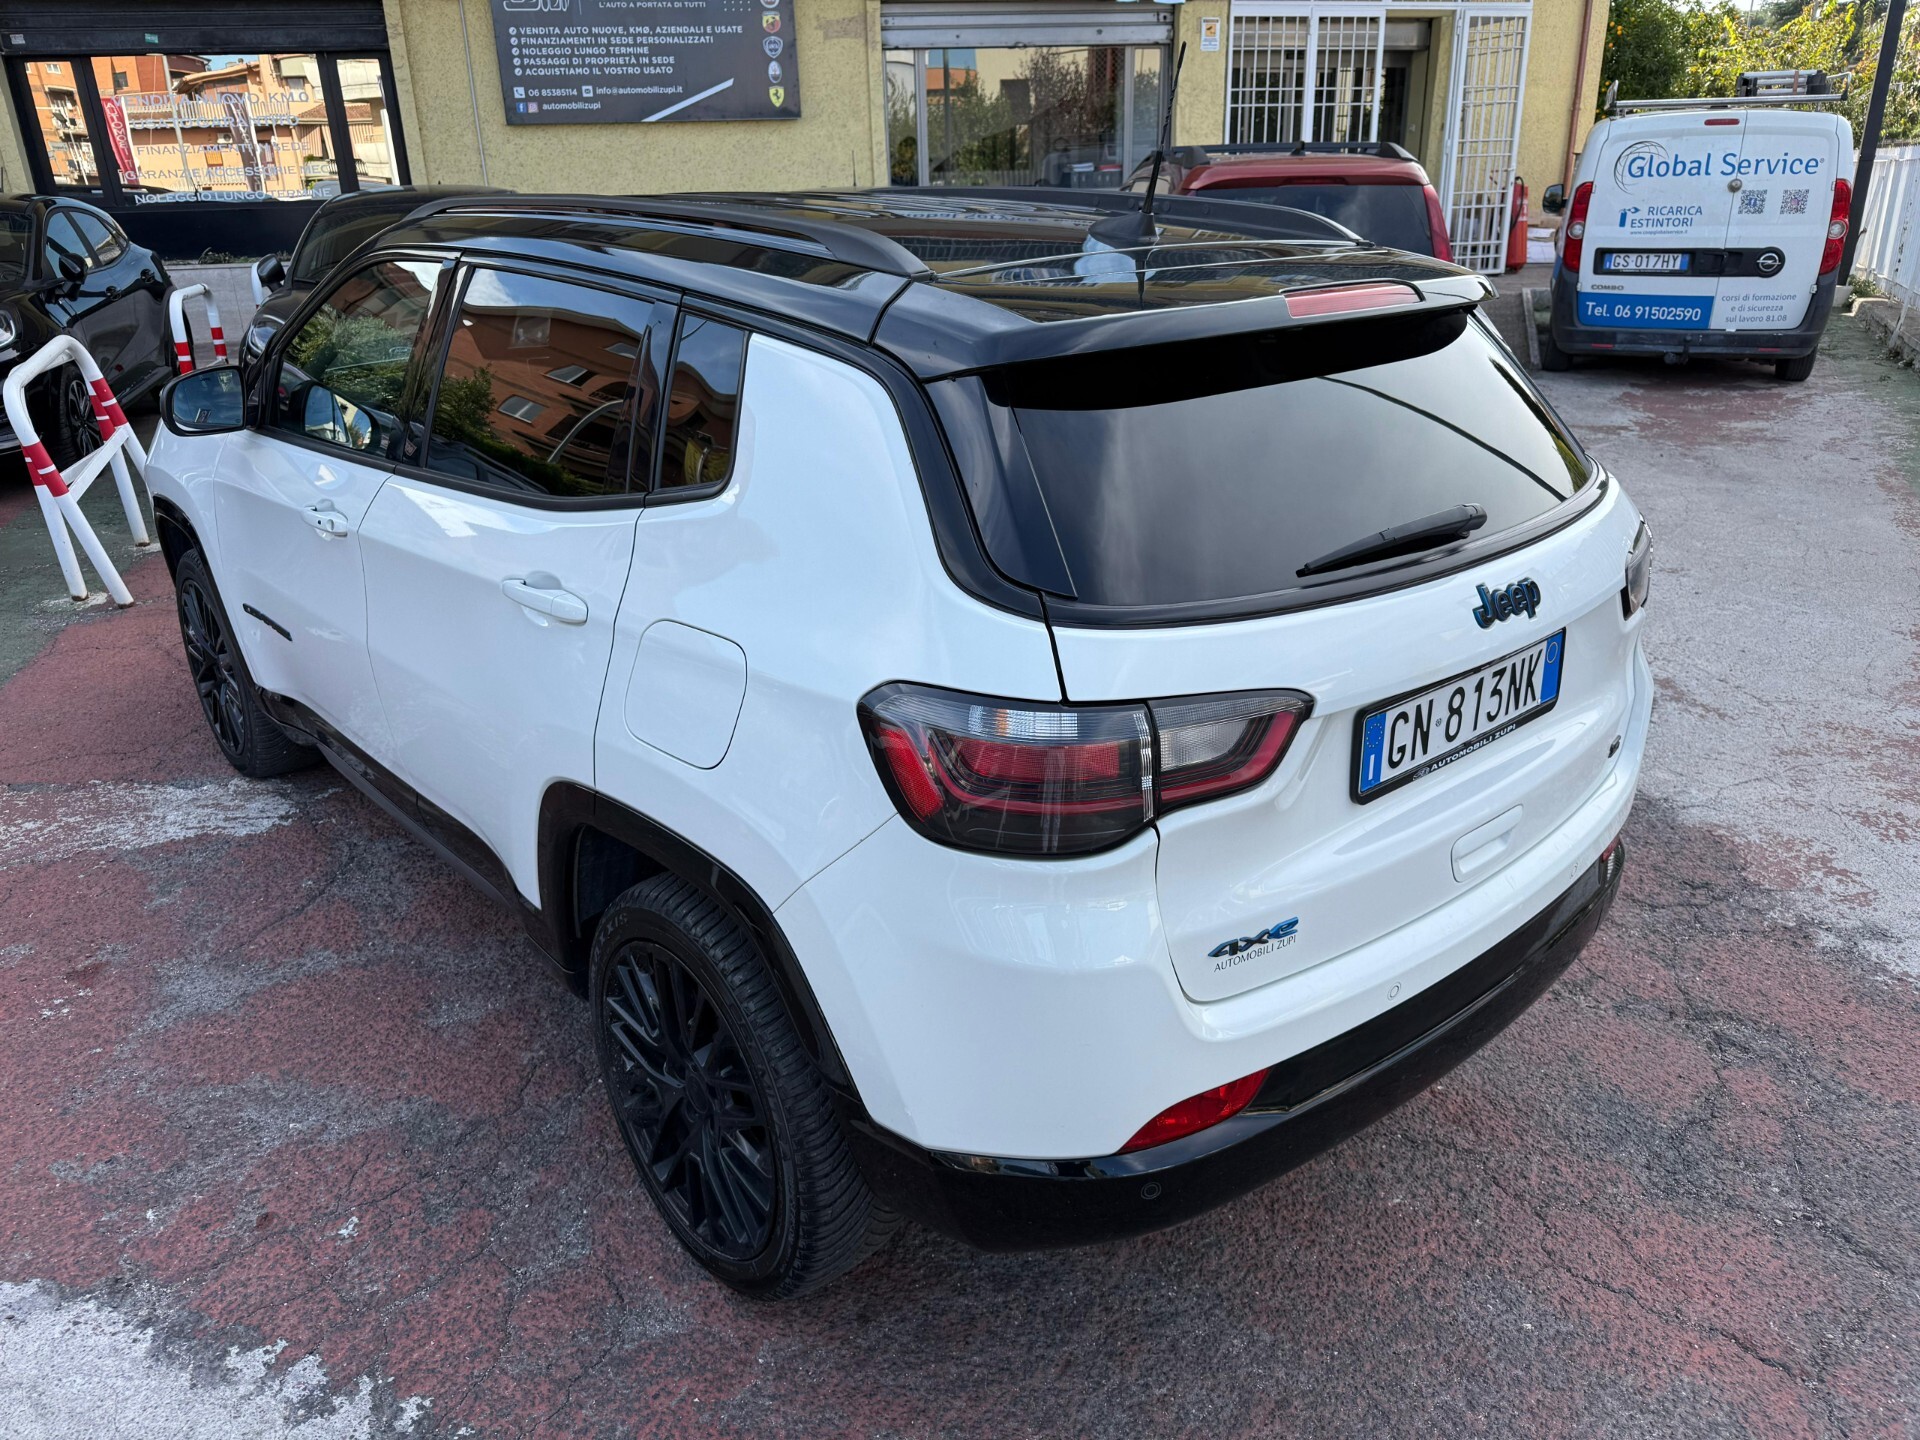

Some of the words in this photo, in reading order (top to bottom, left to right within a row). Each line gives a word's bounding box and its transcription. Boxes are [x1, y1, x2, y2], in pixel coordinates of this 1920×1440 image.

[519, 27, 560, 35] VENDITA
[592, 26, 627, 35] NUOVE,
[655, 26, 704, 34] AZIENDALI
[714, 25, 743, 33] USATE
[521, 37, 595, 45] FINANZIAMENTI
[637, 36, 714, 44] PERSONALIZZATI
[522, 47, 571, 55] NOLEGGIO
[574, 47, 606, 55] LUNGO
[609, 46, 650, 54] TERMINE
[523, 57, 570, 66] PASSAGGI
[585, 55, 636, 65] PROPRIETÀ
[651, 56, 675, 64] SEDE
[525, 67, 590, 76] ACQUISTIAMO
[593, 67, 601, 75] IL
[604, 66, 640, 74] VOSTRO
[644, 66, 673, 74] USATO
[528, 89, 539, 97] 06
[111, 95, 191, 107] VENDITA
[542, 102, 601, 110] automobilizupi
[132, 117, 193, 130] USATO
[1627, 153, 1711, 178] Global
[134, 192, 212, 205] NOLEGGIO
[215, 190, 266, 201] LUNGO
[270, 187, 332, 199] TERMINE
[1647, 206, 1703, 216] RICARICA
[1630, 217, 1693, 228] ESTINTORI
[1721, 294, 1740, 302] corsi
[1742, 293, 1750, 301] di
[1752, 293, 1797, 302] formazione
[1586, 301, 1610, 317] Tel.
[1614, 304, 1631, 318] 06
[1635, 304, 1701, 321] 91502590
[1738, 304, 1746, 312] di
[1747, 304, 1784, 312] sicurezza
[1725, 314, 1736, 322] sul
[1737, 314, 1764, 322] lavoro
[1765, 314, 1787, 322] 81.08
[1472, 577, 1541, 630] Jeep
[1387, 699, 1435, 770] GN
[1444, 648, 1543, 743] 813NK
[1430, 734, 1493, 771] AUTOMOBILI
[1494, 723, 1517, 739] ZUPI
[1213, 943, 1274, 973] AUTOMOBILI
[1276, 934, 1297, 950] ZUPI
